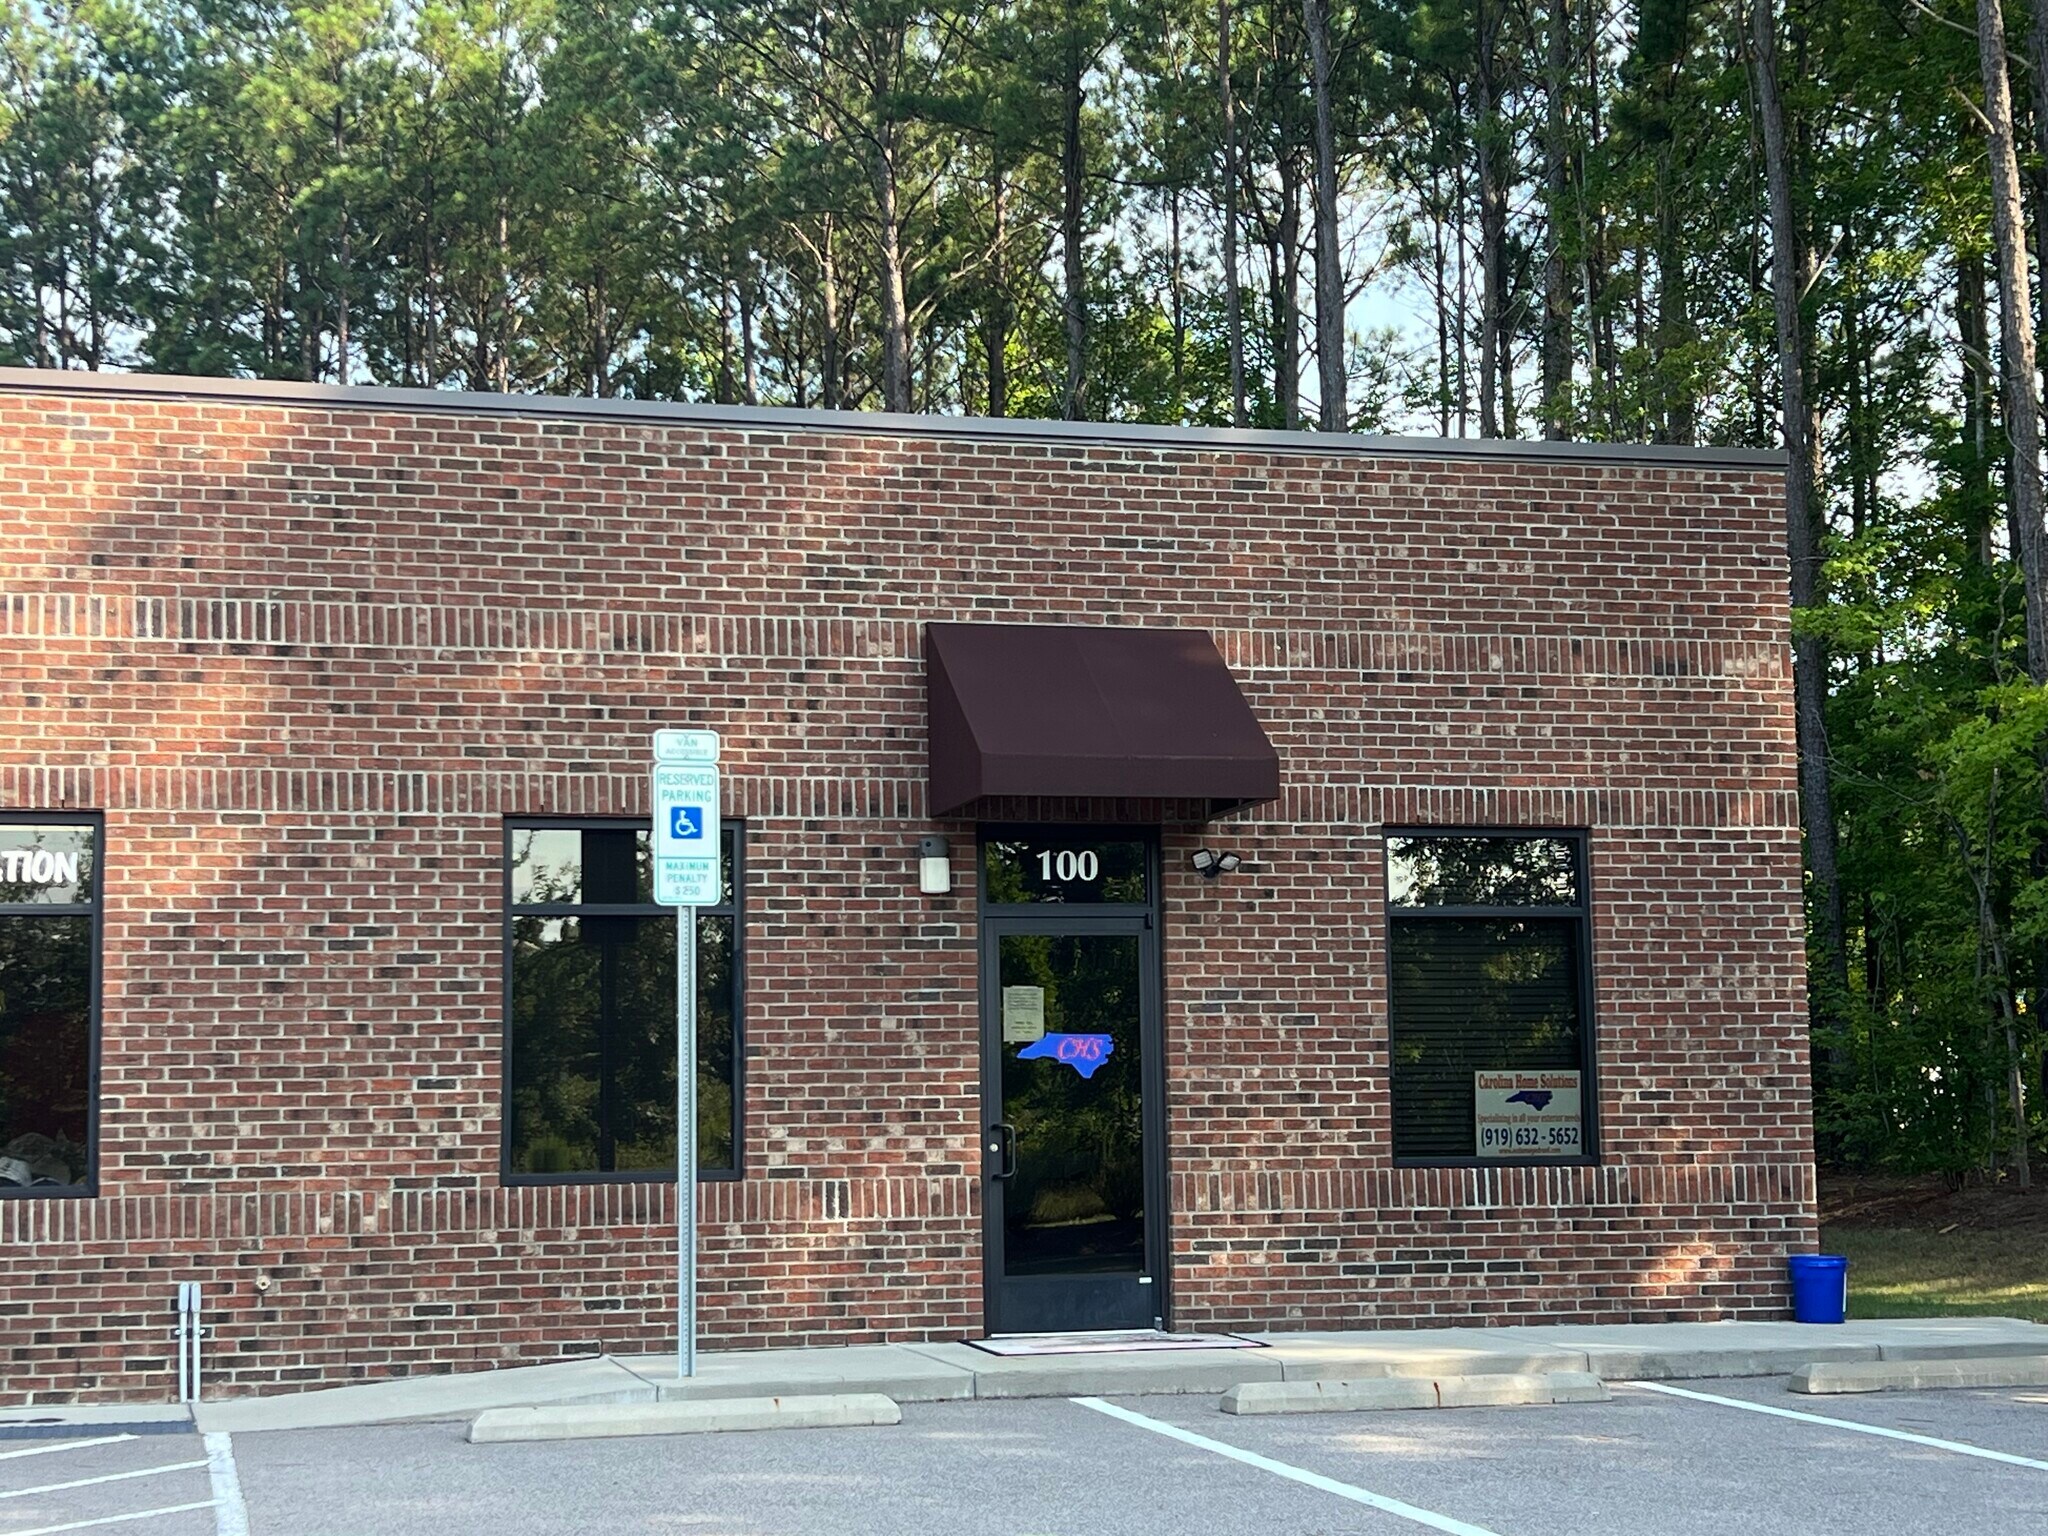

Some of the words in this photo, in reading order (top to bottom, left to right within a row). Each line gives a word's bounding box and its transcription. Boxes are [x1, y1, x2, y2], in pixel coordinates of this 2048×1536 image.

[676, 738, 698, 747] VAN
[659, 773, 714, 786] RESERVED
[661, 789, 712, 802] PARKING
[0, 849, 79, 883] TION
[665, 861, 709, 871] MAXIMUM
[1036, 850, 1099, 882] 100
[666, 873, 708, 883] PENALTY
[1058, 1036, 1103, 1060] CHS
[1478, 1073, 1513, 1089] Carolina
[1515, 1073, 1538, 1089] Home
[1540, 1073, 1578, 1089] Solutions
[1481, 1127, 1512, 1148] (919)
[1515, 1127, 1539, 1145] 632
[1548, 1127, 1579, 1145] 5652
